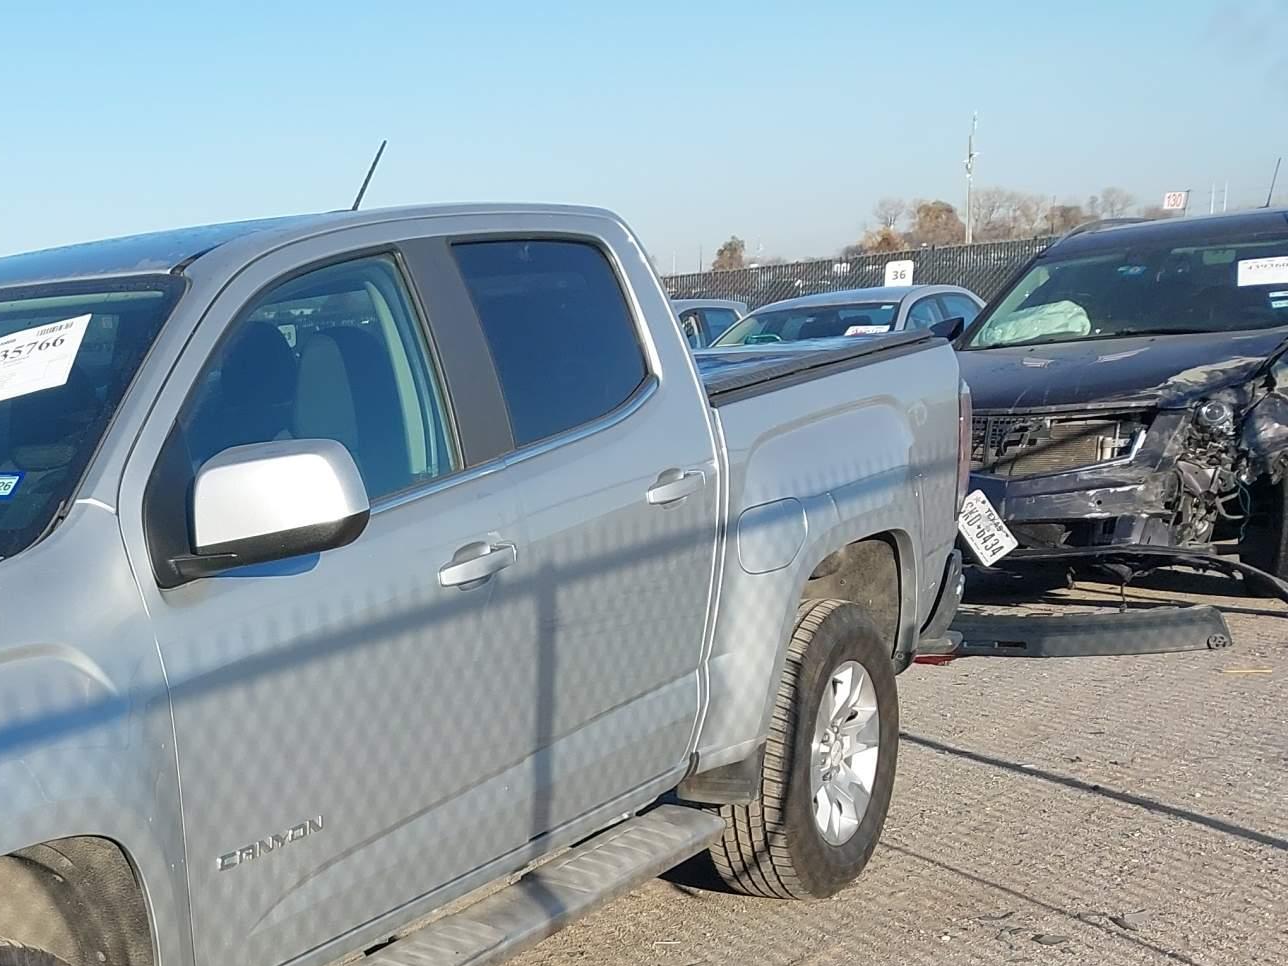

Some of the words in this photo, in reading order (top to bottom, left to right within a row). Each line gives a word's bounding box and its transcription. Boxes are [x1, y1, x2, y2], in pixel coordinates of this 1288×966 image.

[891, 270, 907, 281] 36
[984, 507, 1004, 532] TEXAS
[215, 815, 324, 872] CANYON
